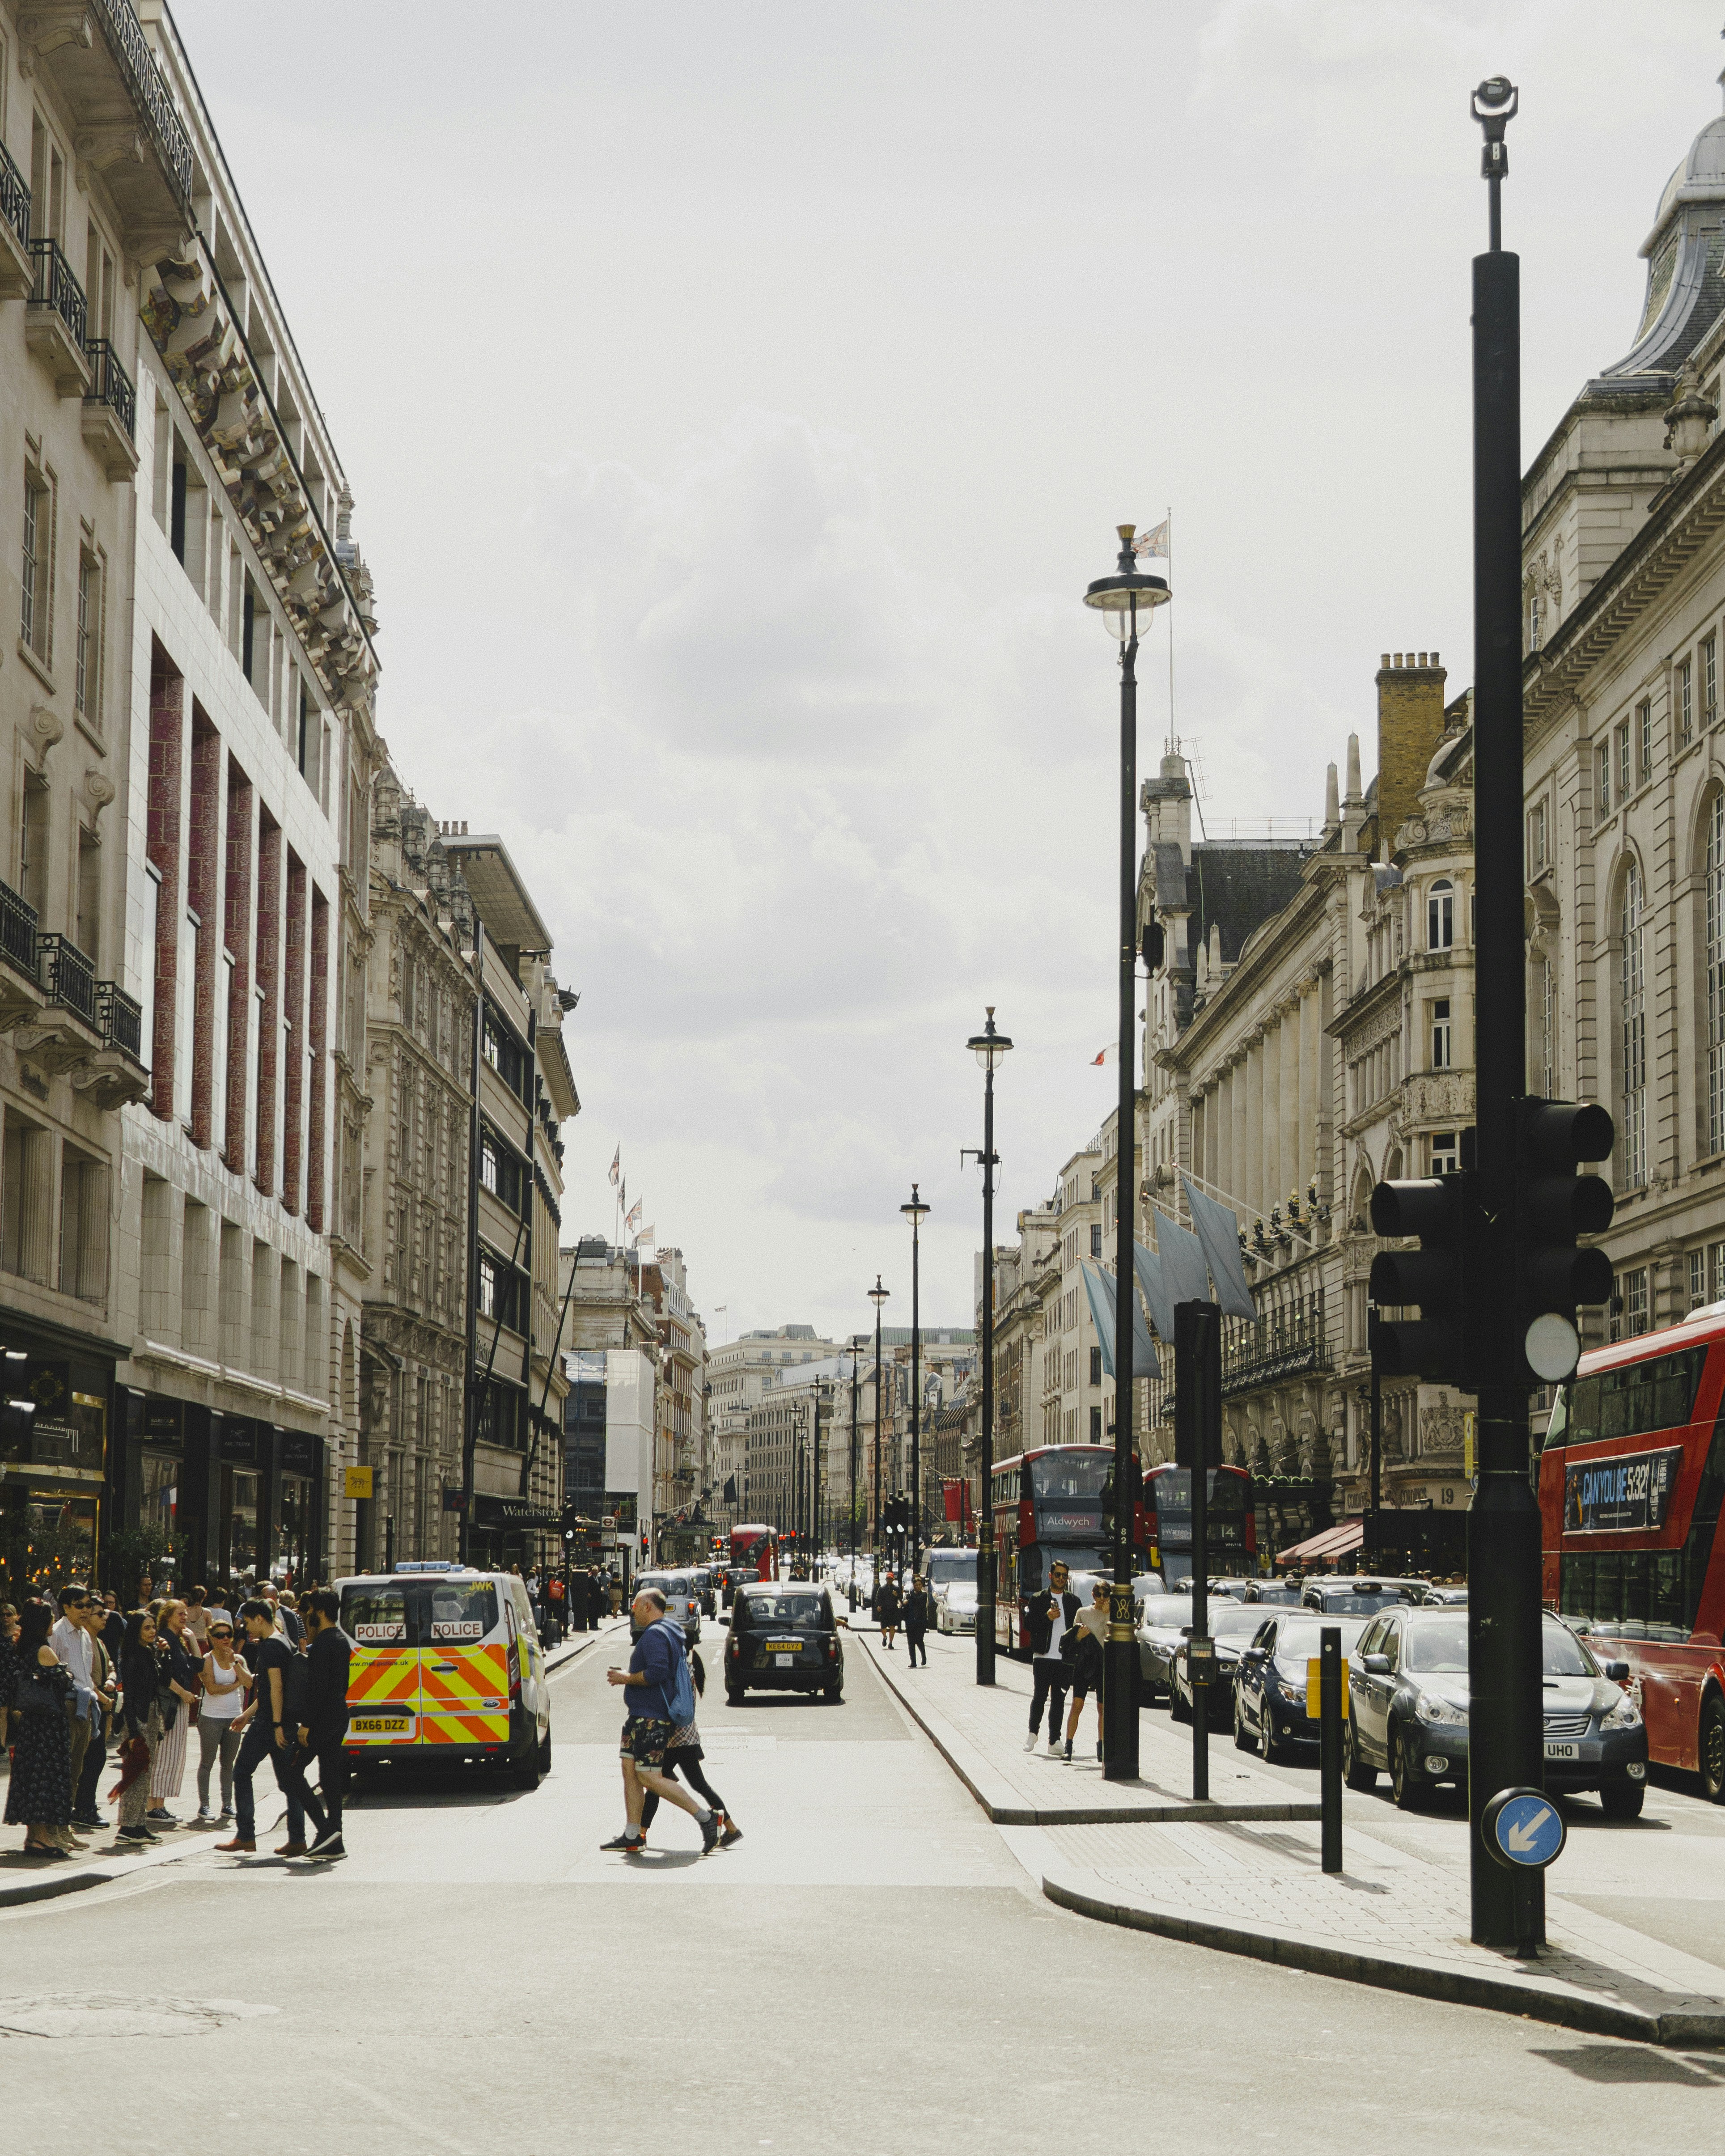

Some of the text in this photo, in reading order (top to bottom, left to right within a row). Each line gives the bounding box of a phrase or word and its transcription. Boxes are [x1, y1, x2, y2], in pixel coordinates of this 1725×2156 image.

[1584, 1471, 1598, 1504] CAN
[1598, 1468, 1615, 1503] YOU
[1616, 1468, 1627, 1502] BE
[1441, 1488, 1453, 1504] 19
[1047, 1516, 1089, 1527] Aldwych
[1221, 1524, 1235, 1538] 14
[468, 1581, 494, 1591] JWK
[358, 1626, 404, 1638] POLICE
[433, 1623, 480, 1636] POLICE
[356, 1720, 405, 1730] BX66 DZZ
[1548, 1744, 1572, 1756] UHO
